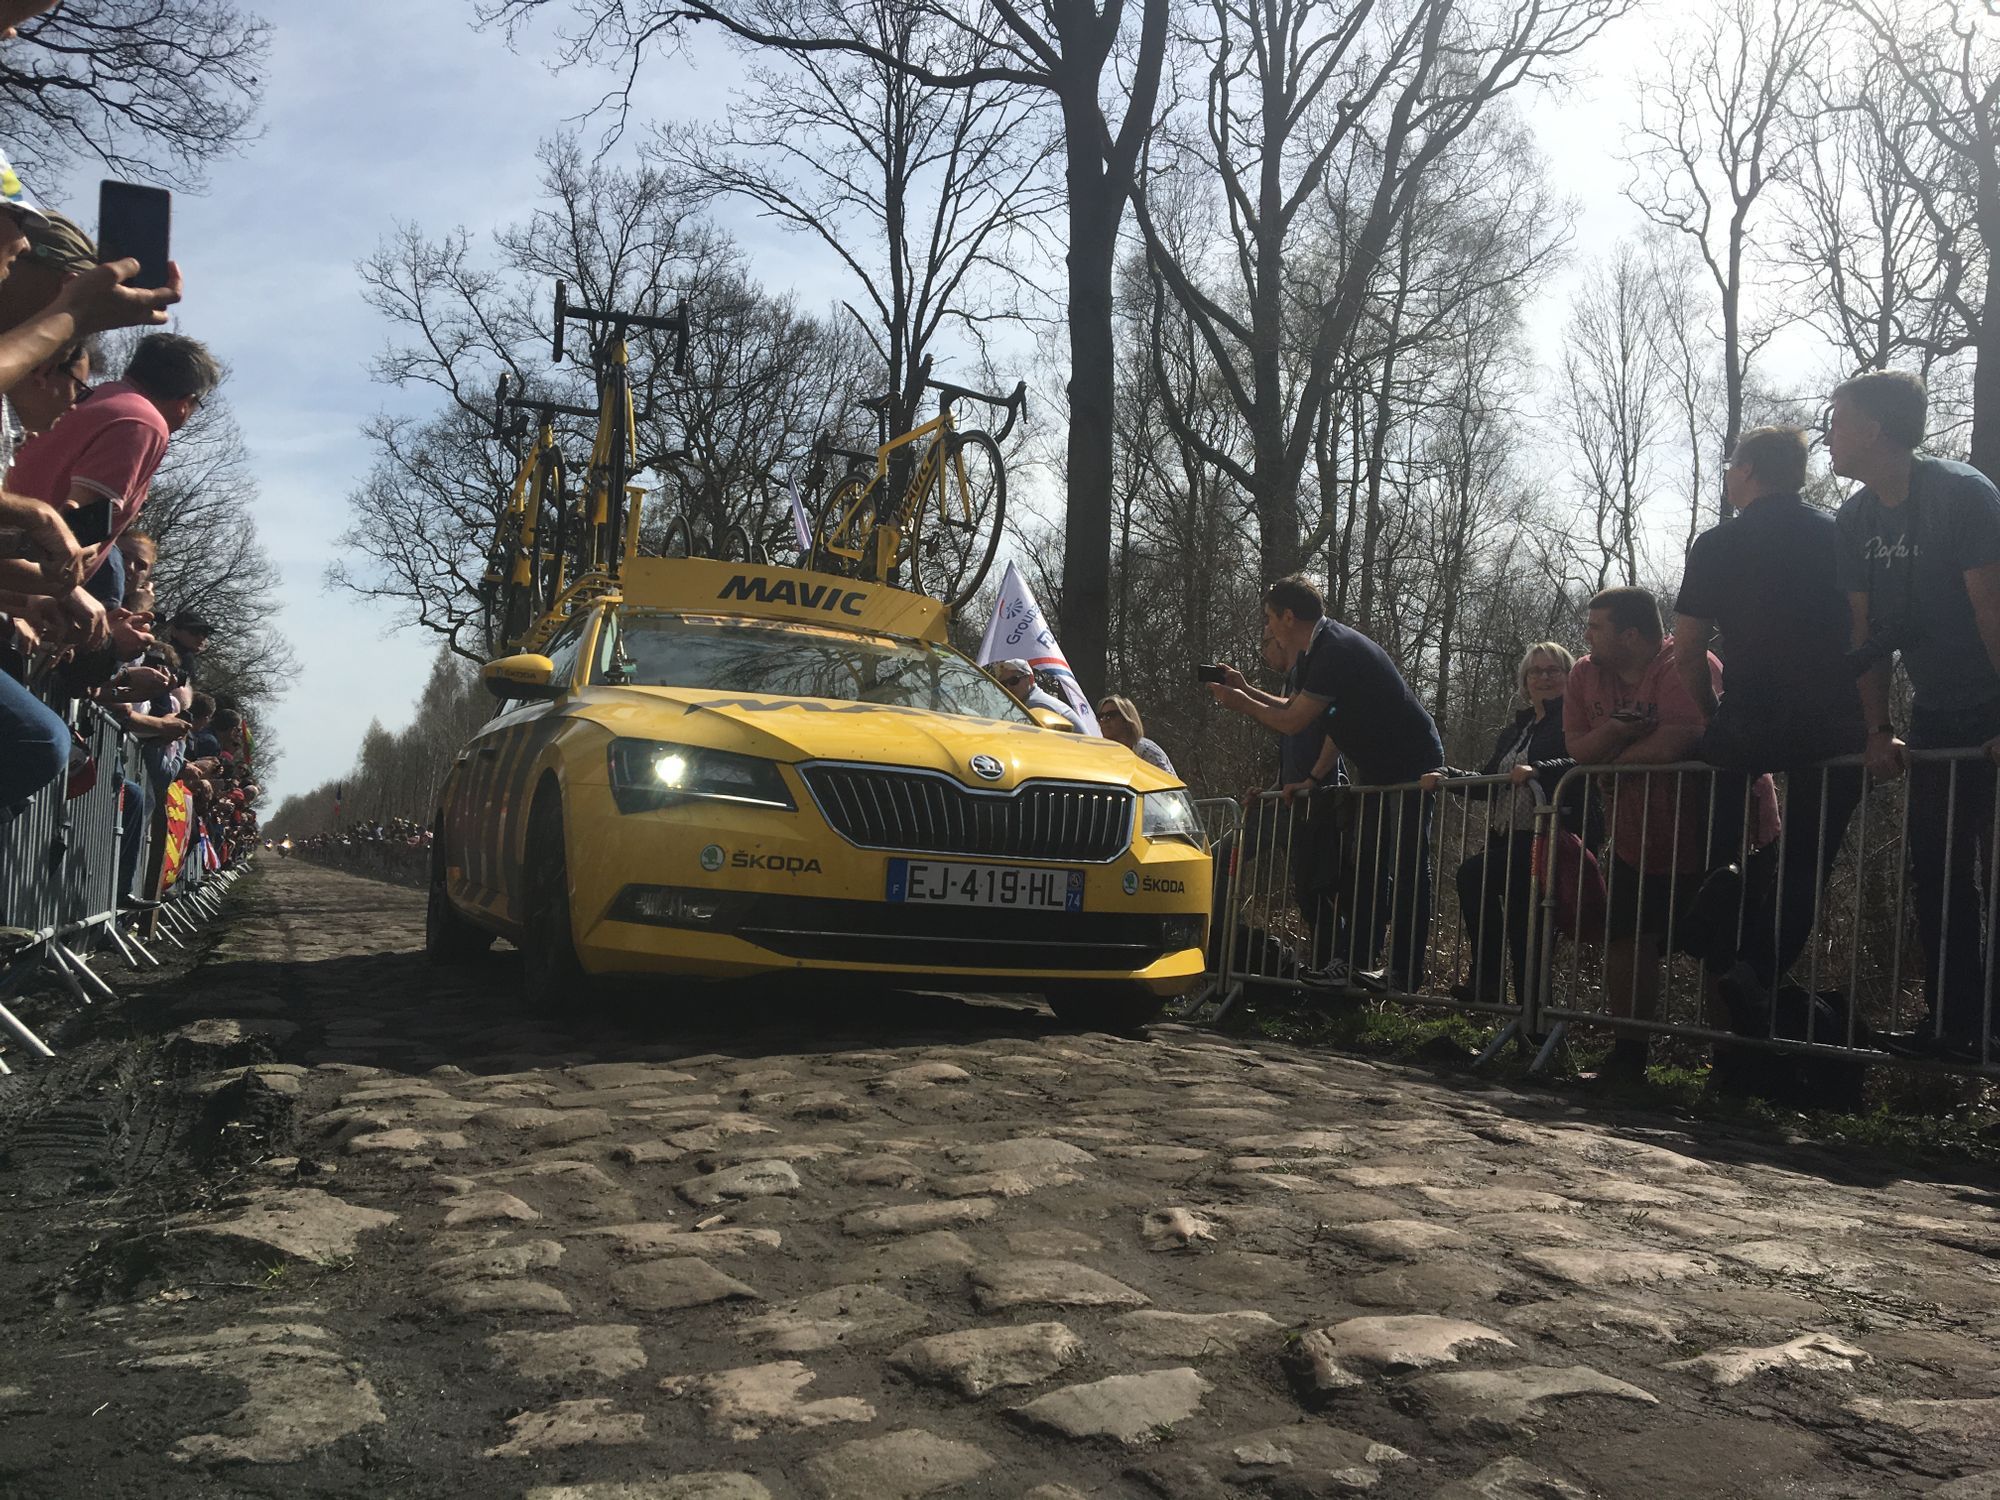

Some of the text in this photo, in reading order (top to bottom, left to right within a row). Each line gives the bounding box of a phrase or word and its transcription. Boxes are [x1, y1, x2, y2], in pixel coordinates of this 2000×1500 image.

[716, 575, 868, 616] MAVIC
[731, 850, 822, 874] ŠKODA
[892, 884, 899, 895] F
[907, 865, 1064, 907] EJ-419-HL
[1142, 875, 1185, 894] ŠKODA
[1066, 892, 1081, 907] 74
